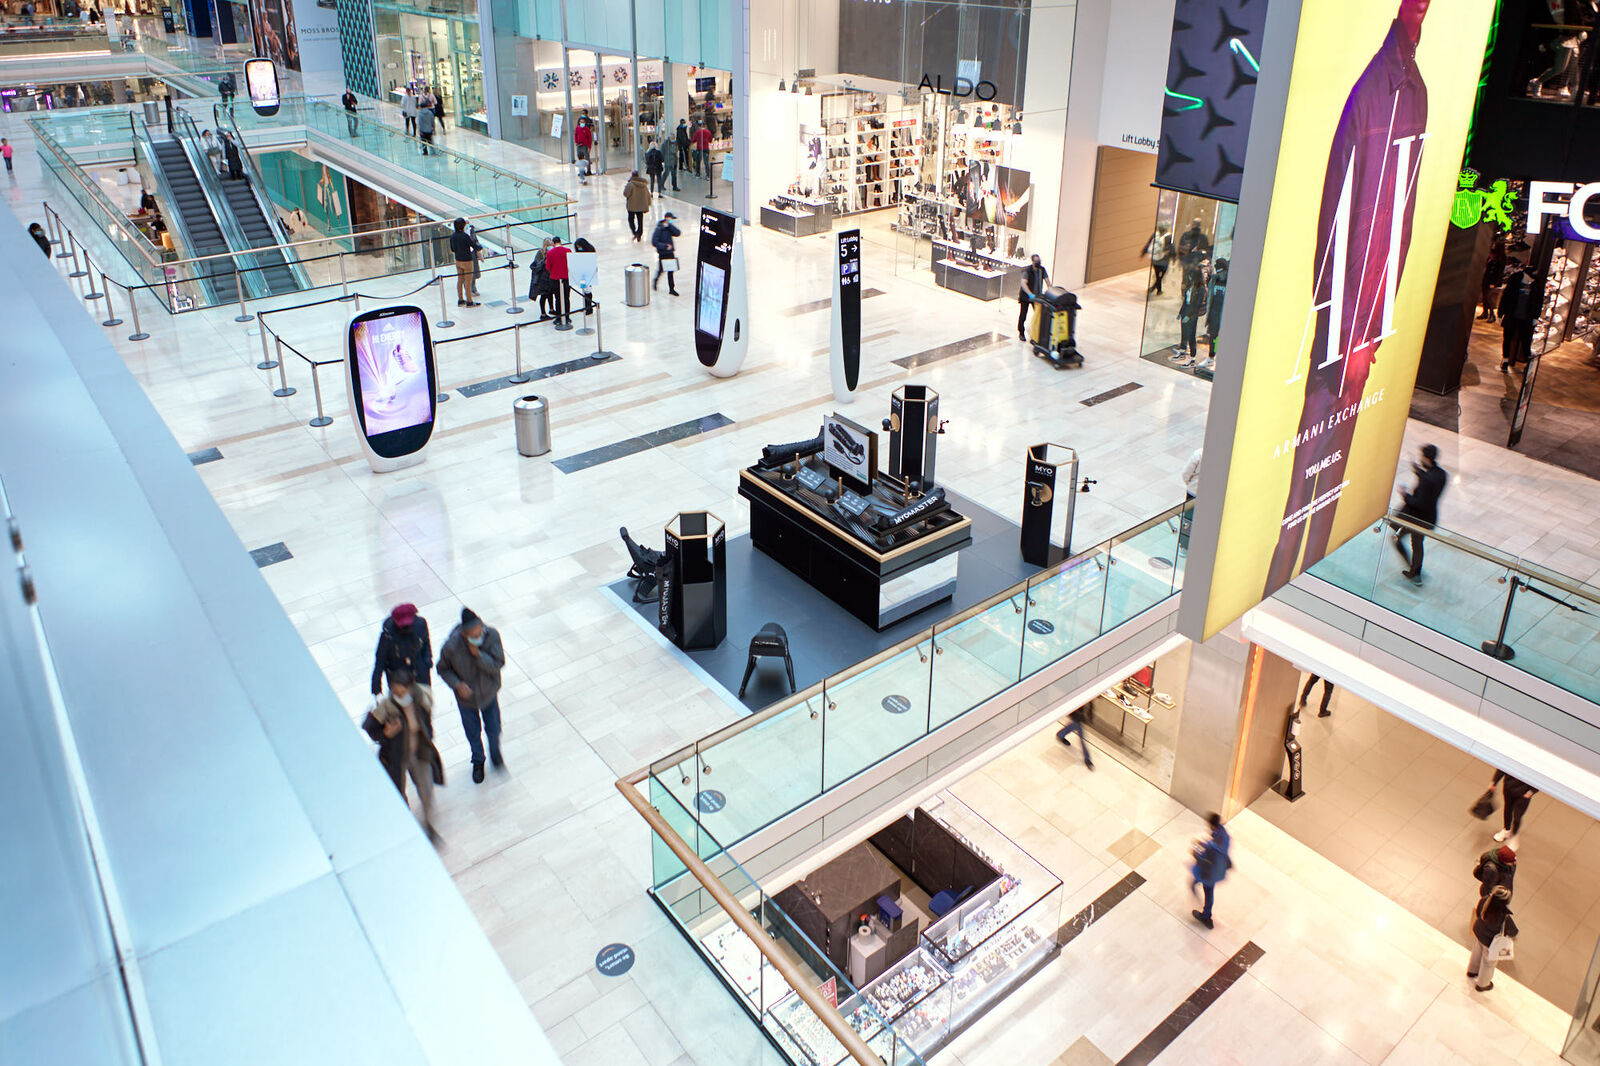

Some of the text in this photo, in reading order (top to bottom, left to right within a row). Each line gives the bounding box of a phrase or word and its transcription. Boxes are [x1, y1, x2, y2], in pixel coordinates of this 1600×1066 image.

[918, 73, 998, 101] ALDO
[1122, 133, 1133, 144] Lift
[1134, 136, 1156, 149] Lobby
[840, 244, 848, 258] 5
[1272, 388, 1384, 460] ARMANI EXCHANGE
[1034, 464, 1053, 474] MYO
[894, 496, 938, 525] MYOMASTER
[666, 533, 679, 547] MYO
